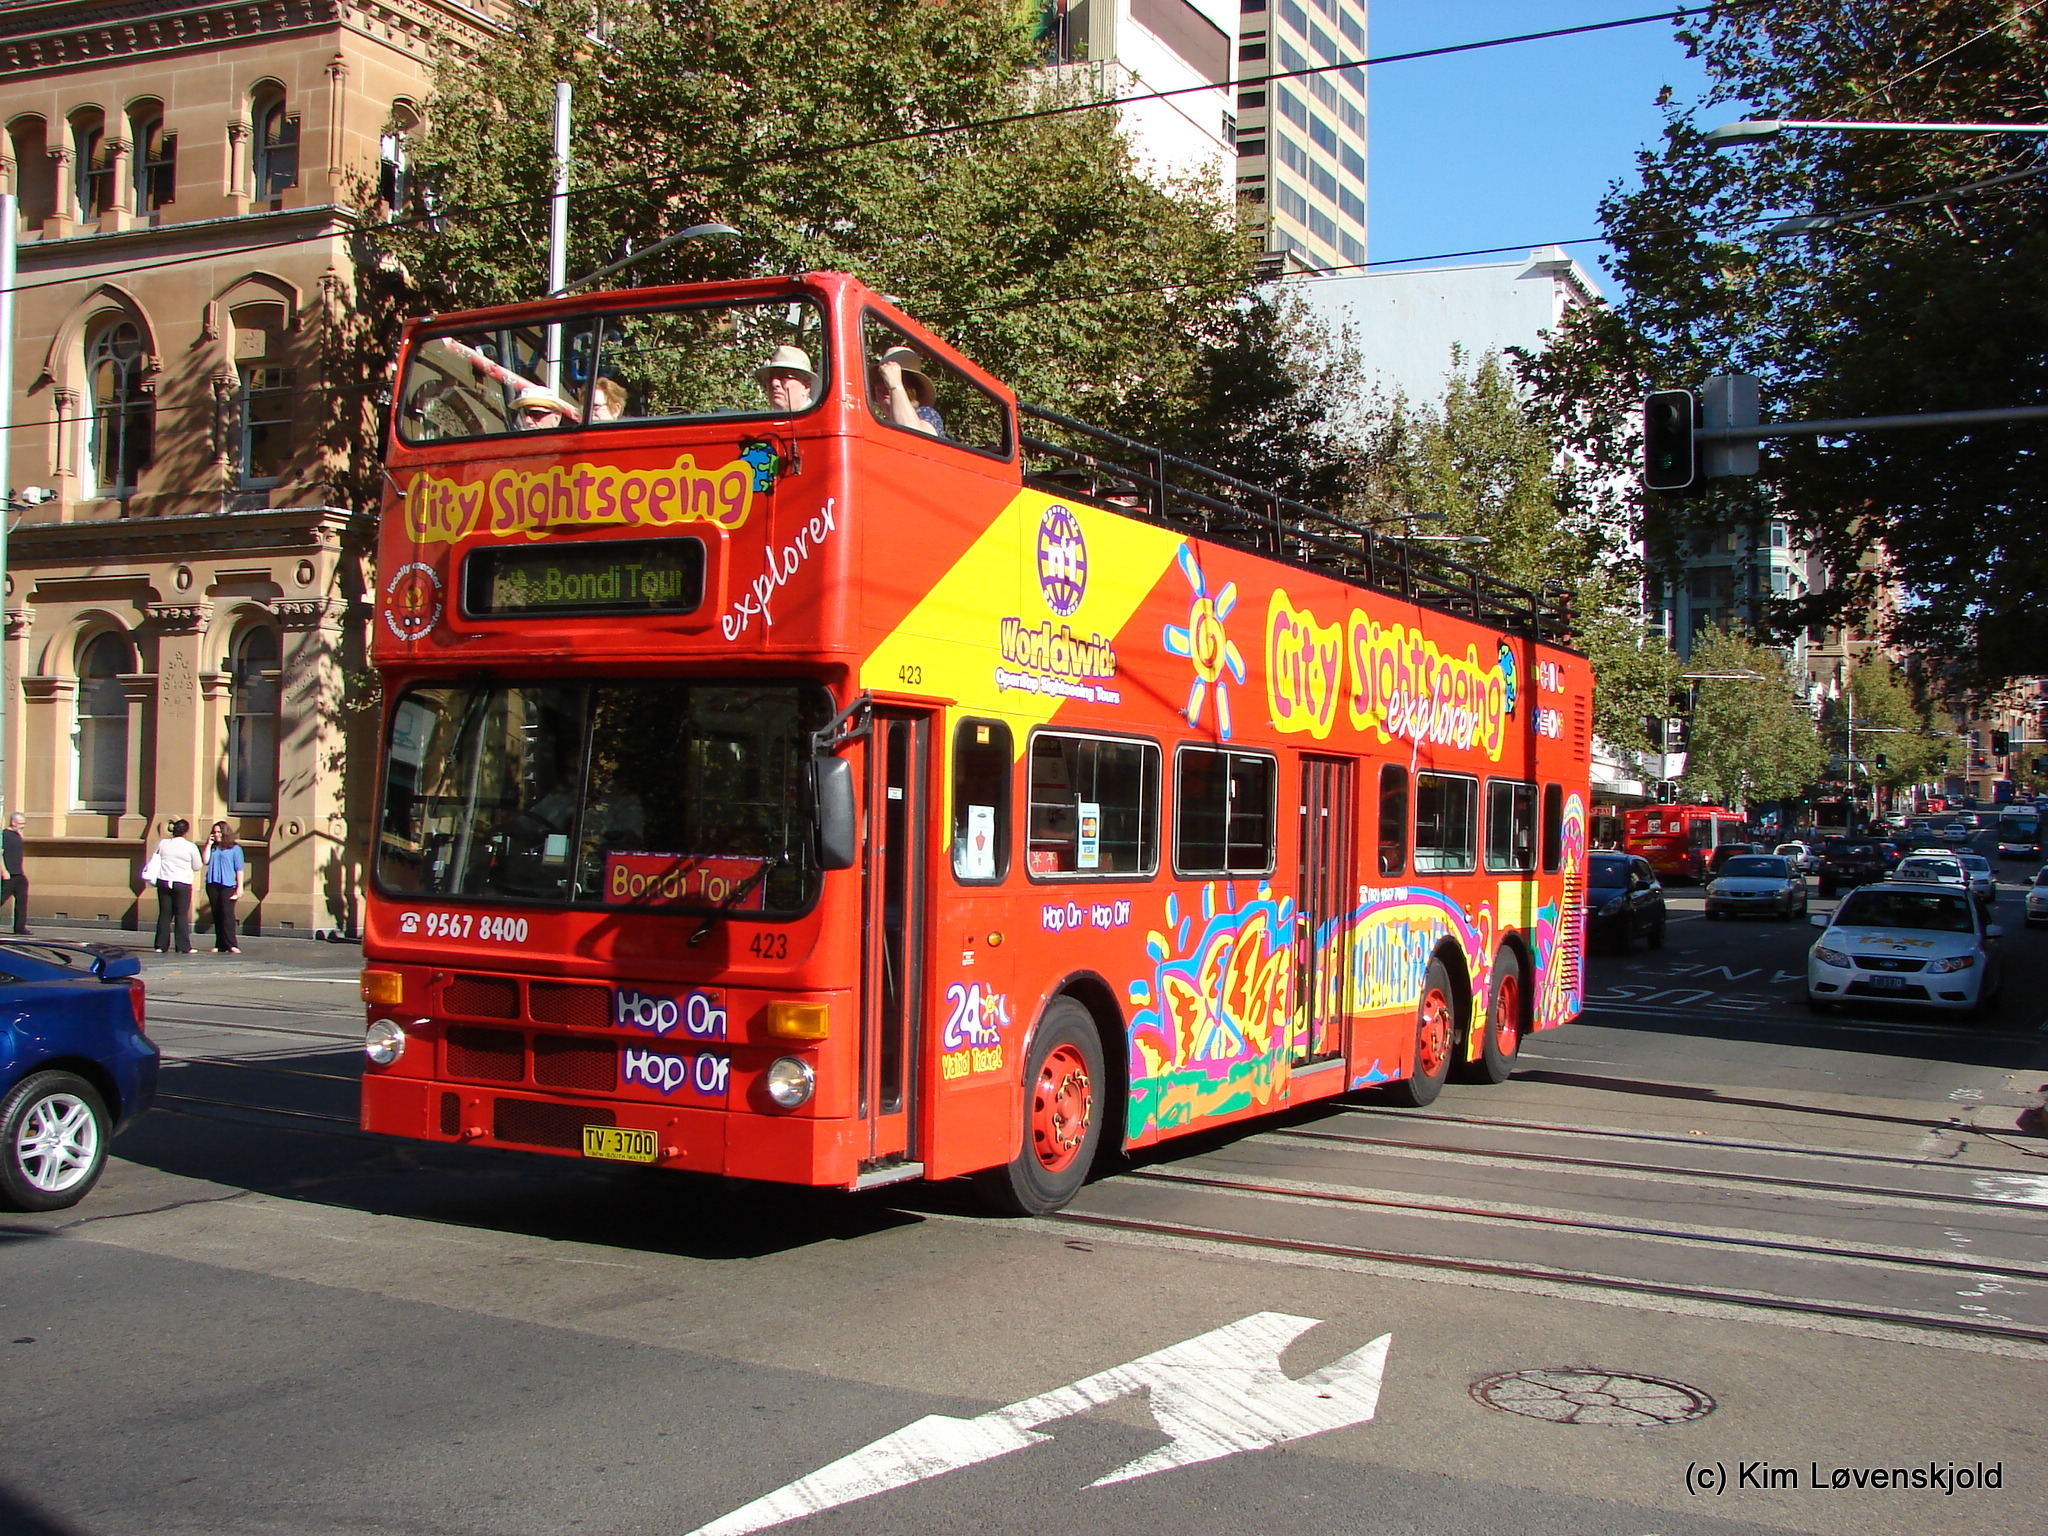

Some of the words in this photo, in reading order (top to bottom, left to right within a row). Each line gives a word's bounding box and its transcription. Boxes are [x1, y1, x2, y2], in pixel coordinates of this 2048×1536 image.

[409, 475, 483, 536] City
[494, 460, 747, 531] Sightseeing
[387, 564, 411, 593] locally
[546, 566, 620, 600] Bondi
[625, 564, 682, 598] Tour
[722, 498, 835, 641] explorer
[384, 610, 408, 641] globally
[409, 603, 442, 641] connected
[1001, 618, 1116, 679] Worldwide
[898, 665, 922, 686] 423
[1041, 676, 1094, 702] Sightseeing
[1095, 685, 1120, 704] Tours
[1271, 608, 1340, 728] City
[1352, 620, 1501, 753] Sightseeing
[1388, 674, 1479, 774] explorer
[613, 865, 687, 899] Bondi
[699, 868, 748, 903] Tou
[1902, 870, 1930, 878] TAXI
[426, 912, 474, 938] 9567
[479, 916, 528, 942] 8400
[1043, 905, 1065, 931] Hop
[1067, 901, 1083, 928] On
[1092, 904, 1113, 930] Hop
[1114, 900, 1131, 926] Off
[750, 932, 788, 960] 423
[1859, 936, 1935, 948] TAXI
[618, 990, 678, 1034] Hop
[687, 994, 727, 1035] On
[945, 983, 981, 1048] 24
[626, 1047, 685, 1091] Hop
[942, 1050, 970, 1080] Valid
[972, 1044, 1003, 1073] Ticket
